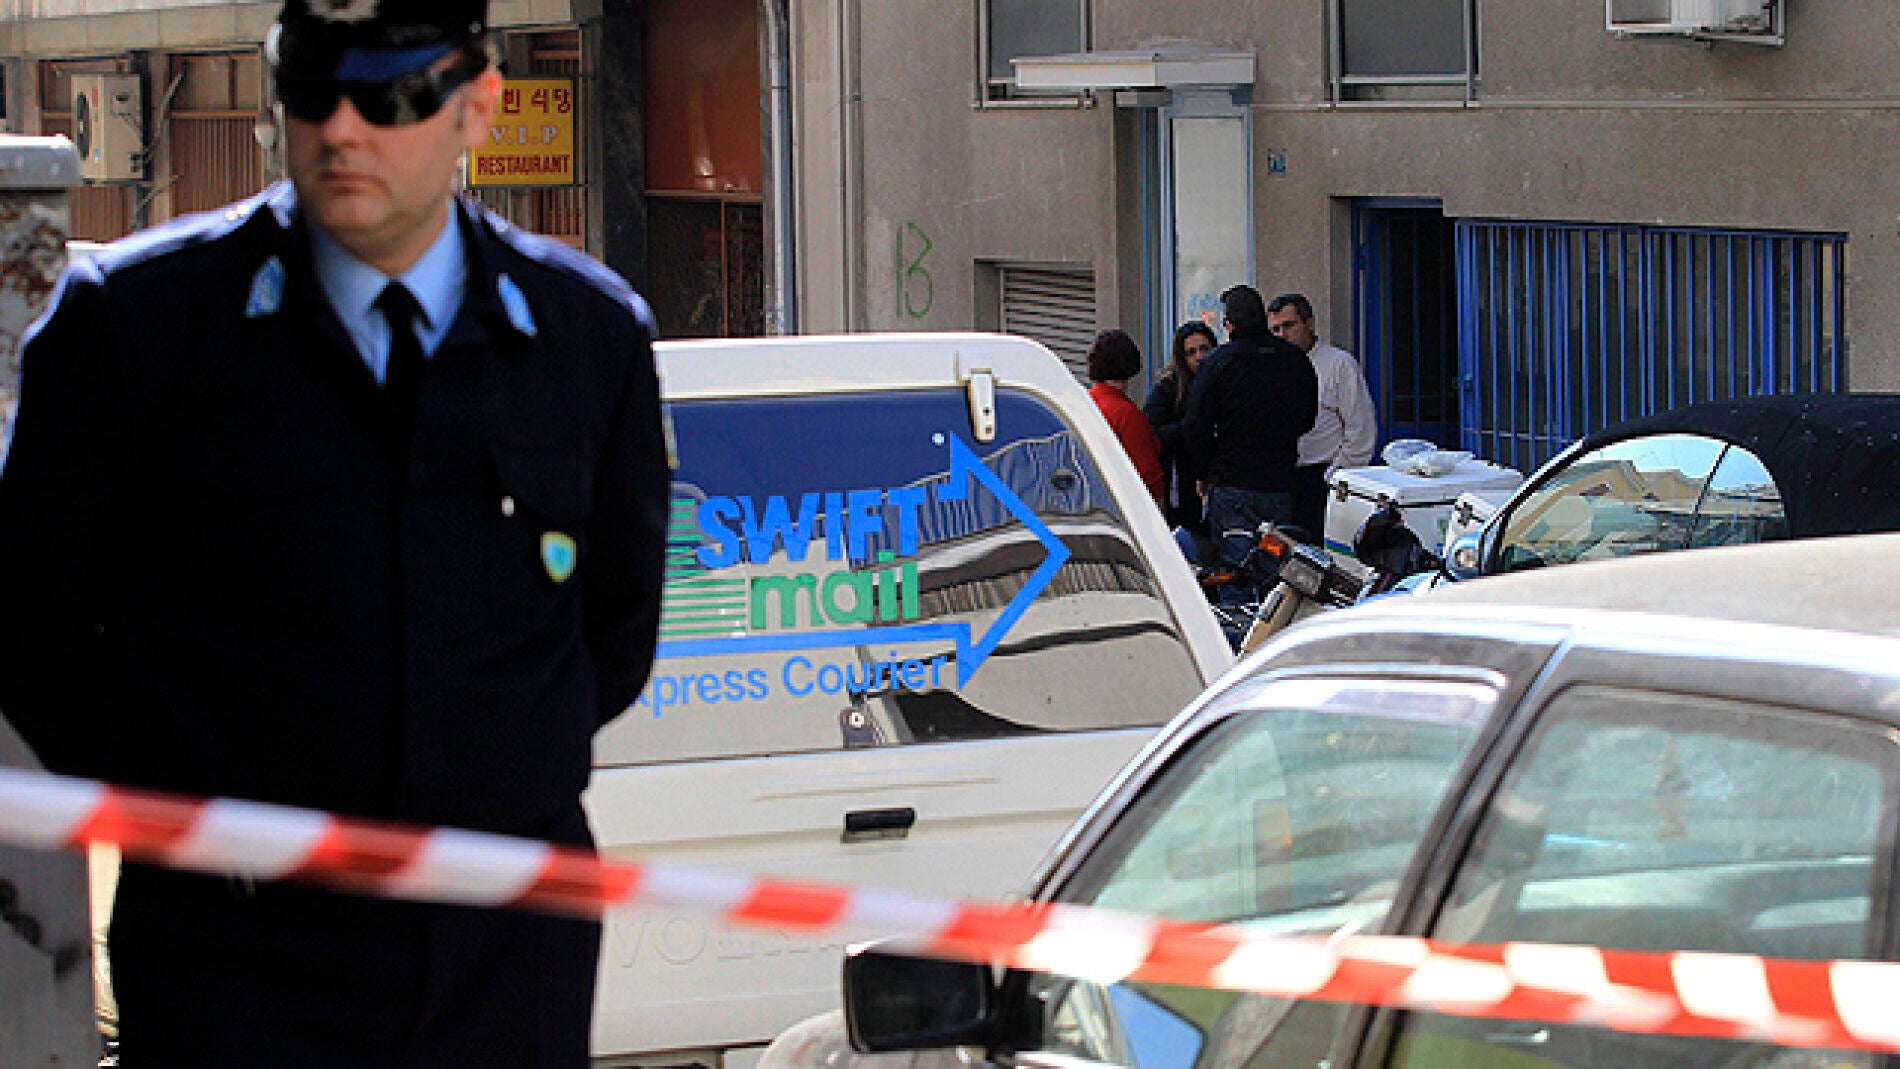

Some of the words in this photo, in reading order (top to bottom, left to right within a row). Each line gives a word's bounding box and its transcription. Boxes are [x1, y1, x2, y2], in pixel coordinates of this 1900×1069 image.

[502, 88, 521, 114] 빈
[531, 88, 572, 114] 식당
[490, 125, 559, 145] V.I.P
[477, 153, 571, 176] RESTAURANT
[697, 487, 926, 570] SWIFT
[750, 550, 920, 629] mail
[783, 650, 947, 696] Courier
